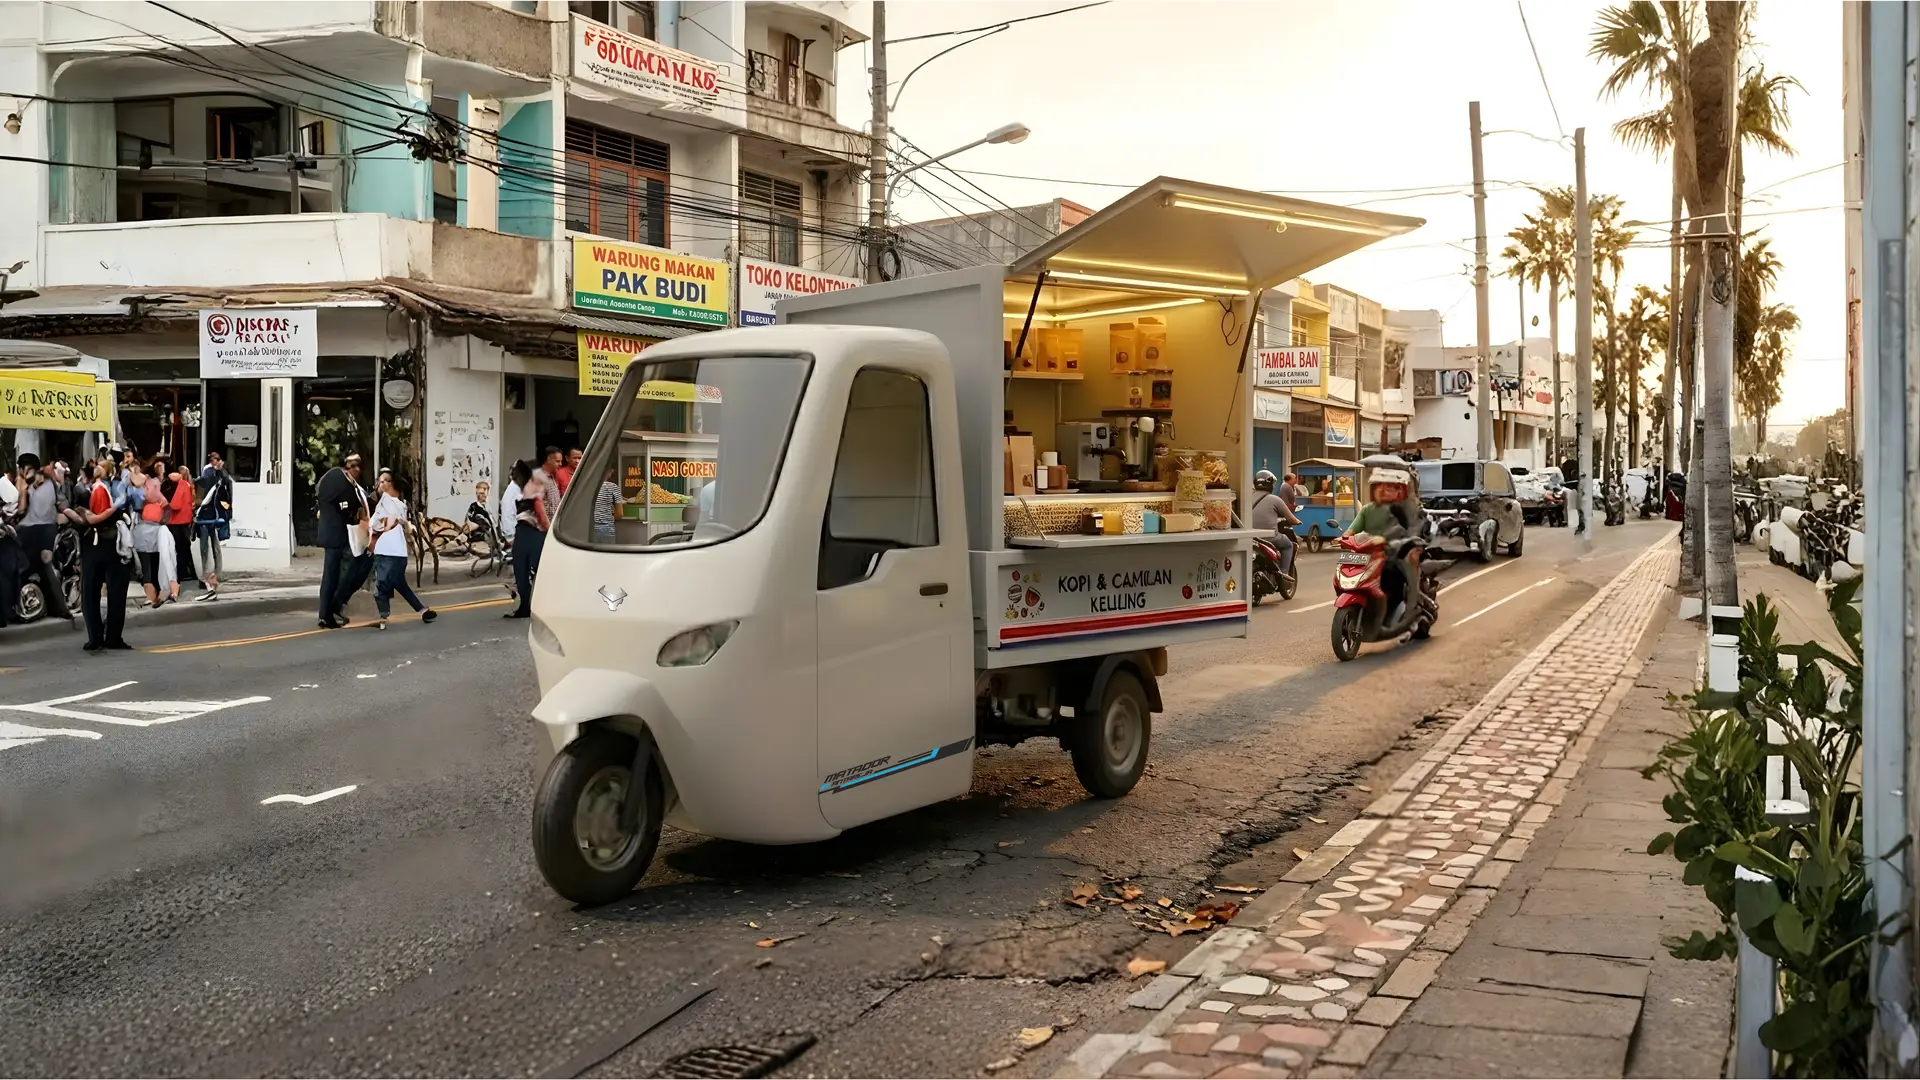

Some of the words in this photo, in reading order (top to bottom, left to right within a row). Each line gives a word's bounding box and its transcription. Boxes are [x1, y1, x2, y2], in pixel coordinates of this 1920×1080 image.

[592, 246, 660, 272] WARUNG
[665, 259, 715, 281] MAKAN
[602, 269, 648, 296] PAK
[656, 277, 706, 304] BUDI
[746, 264, 782, 288] TOKO
[786, 271, 856, 294] KELONTON
[1260, 352, 1297, 369] TAMBAL
[1299, 351, 1319, 368] BAN
[652, 461, 679, 477] NASI
[681, 461, 717, 478] GOREN
[1058, 574, 1091, 594] KOPI
[1096, 573, 1107, 591] &
[1111, 569, 1172, 589] CAMILAN
[823, 754, 892, 784] MATADOR
